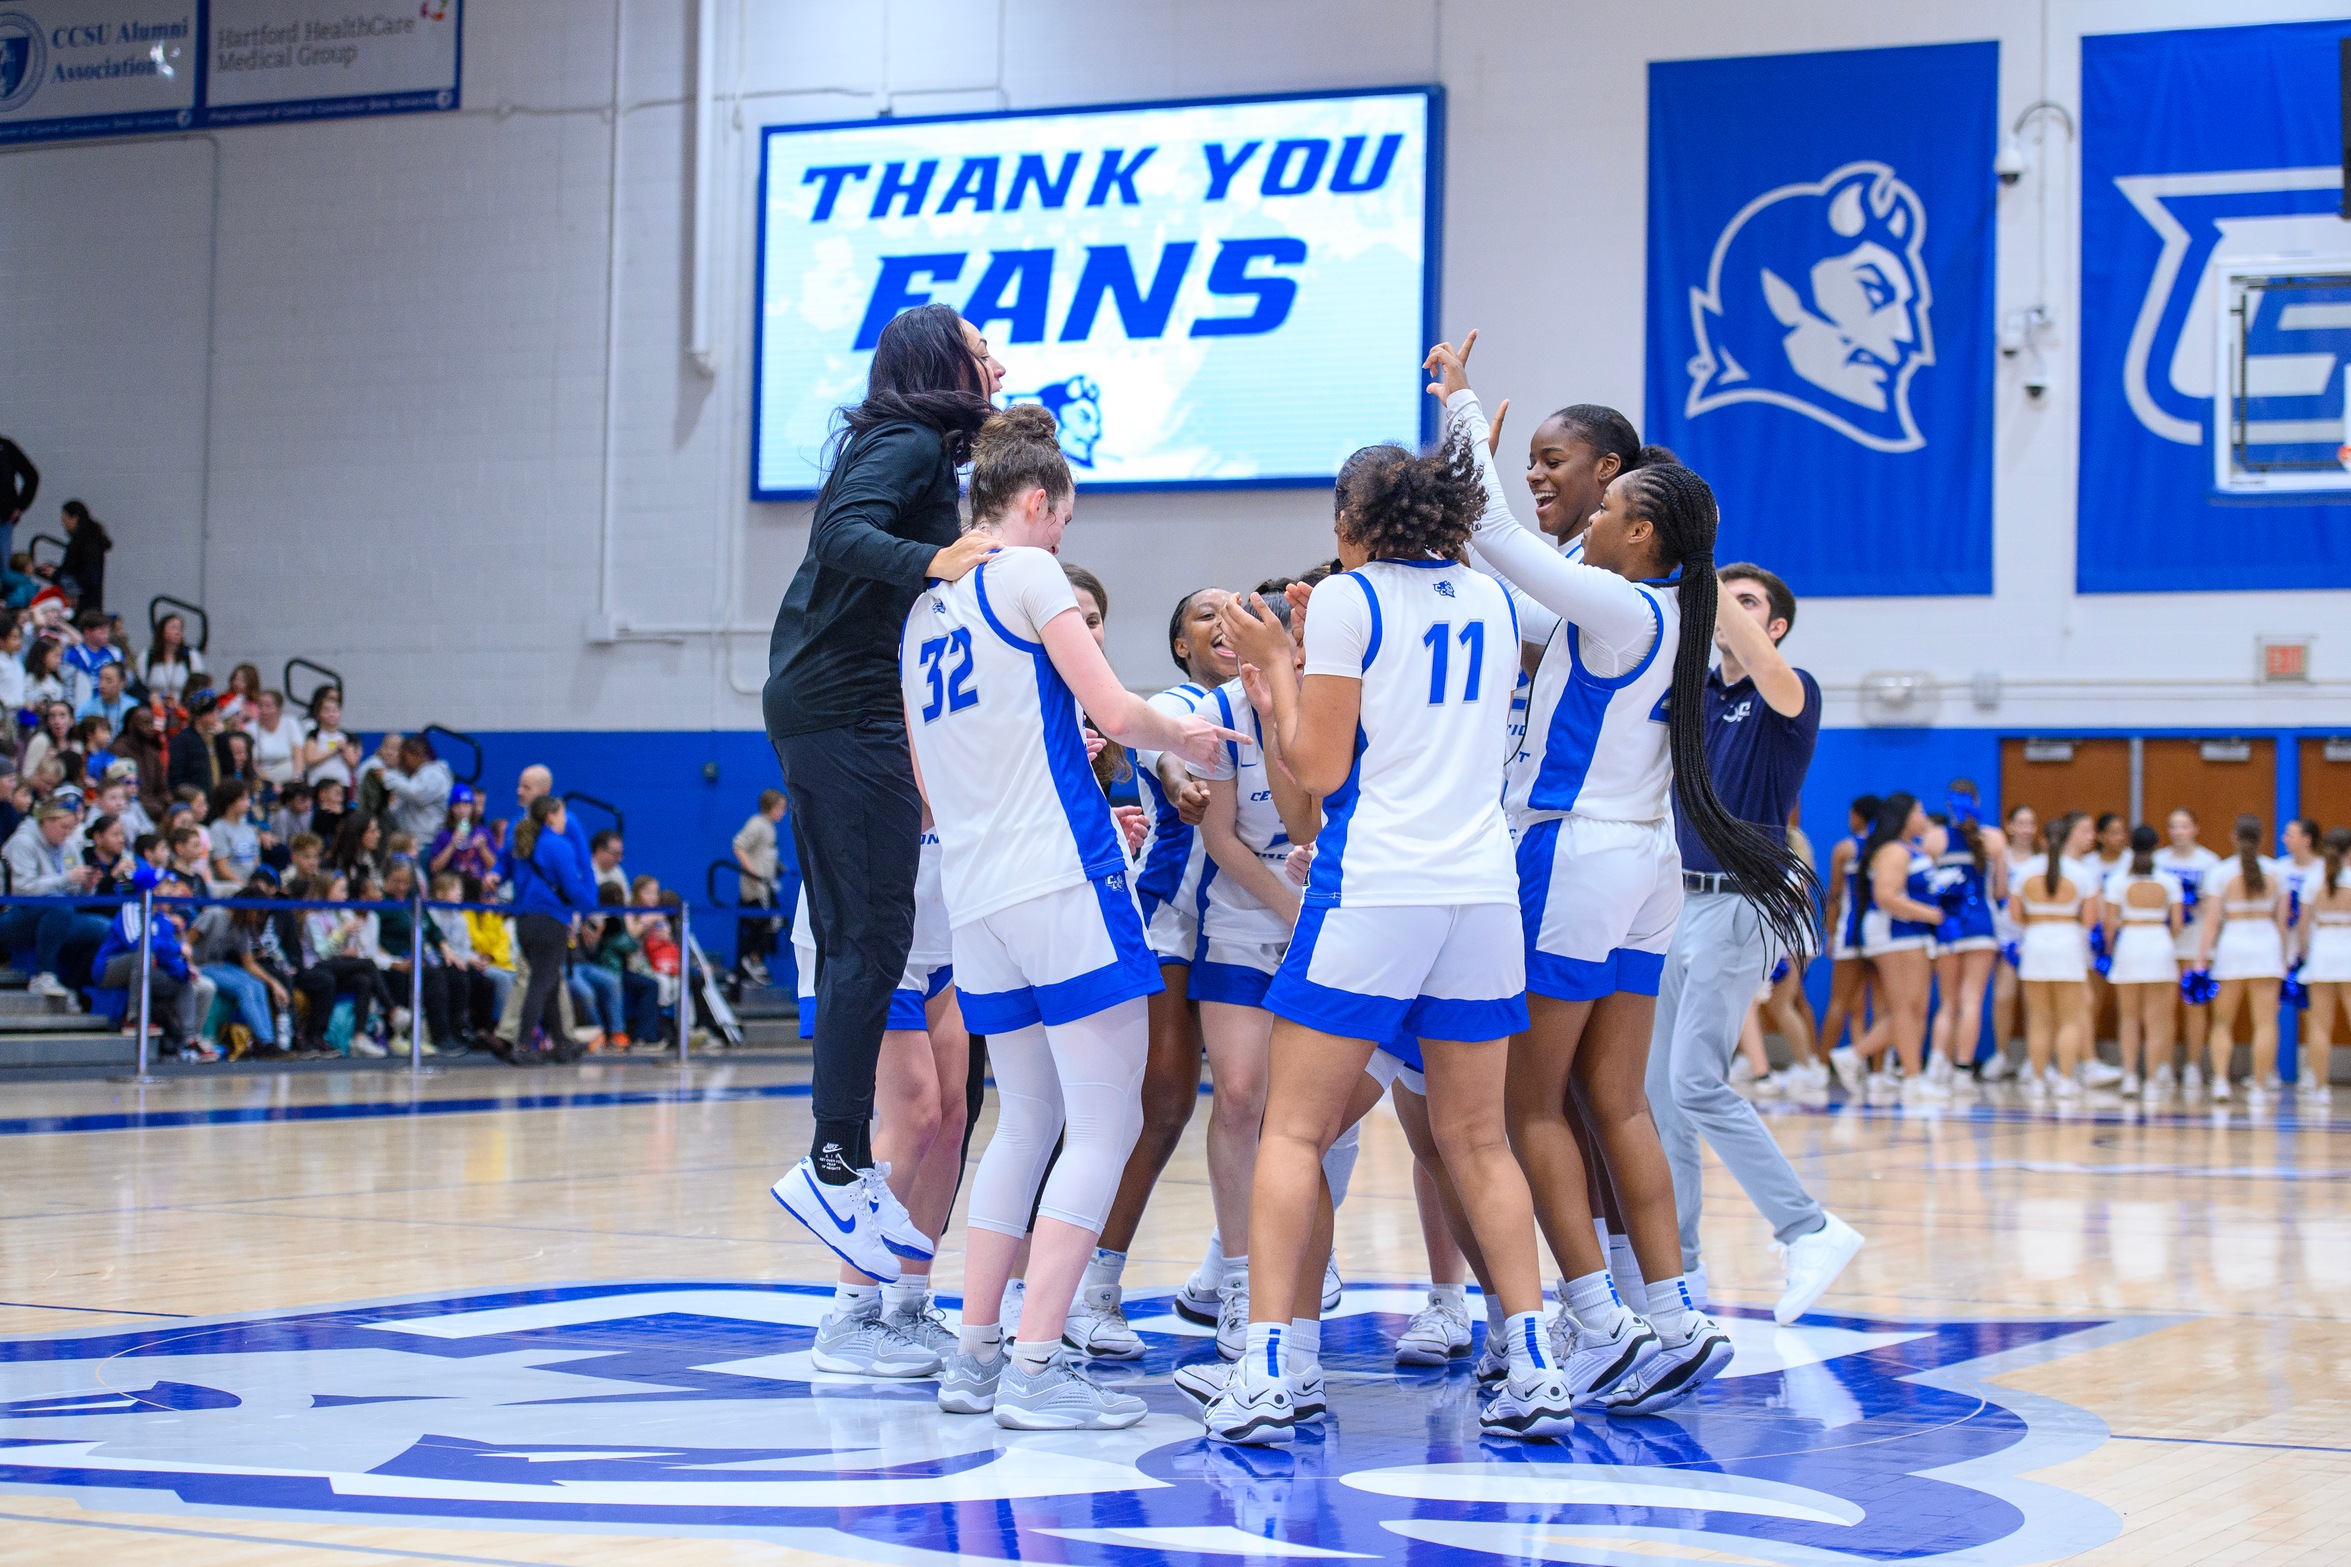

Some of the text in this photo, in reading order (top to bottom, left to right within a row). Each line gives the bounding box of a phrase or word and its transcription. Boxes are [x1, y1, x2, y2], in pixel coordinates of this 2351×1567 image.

[52, 16, 189, 49] CCSU Alumni
[216, 15, 415, 49] Hartford HealthCare
[216, 44, 358, 72] Medical Group
[52, 55, 159, 83] Association
[801, 134, 1405, 222] THANK YOU
[852, 236, 1307, 351] FANS
[919, 623, 980, 726] 32
[1421, 618, 1485, 707] 11
